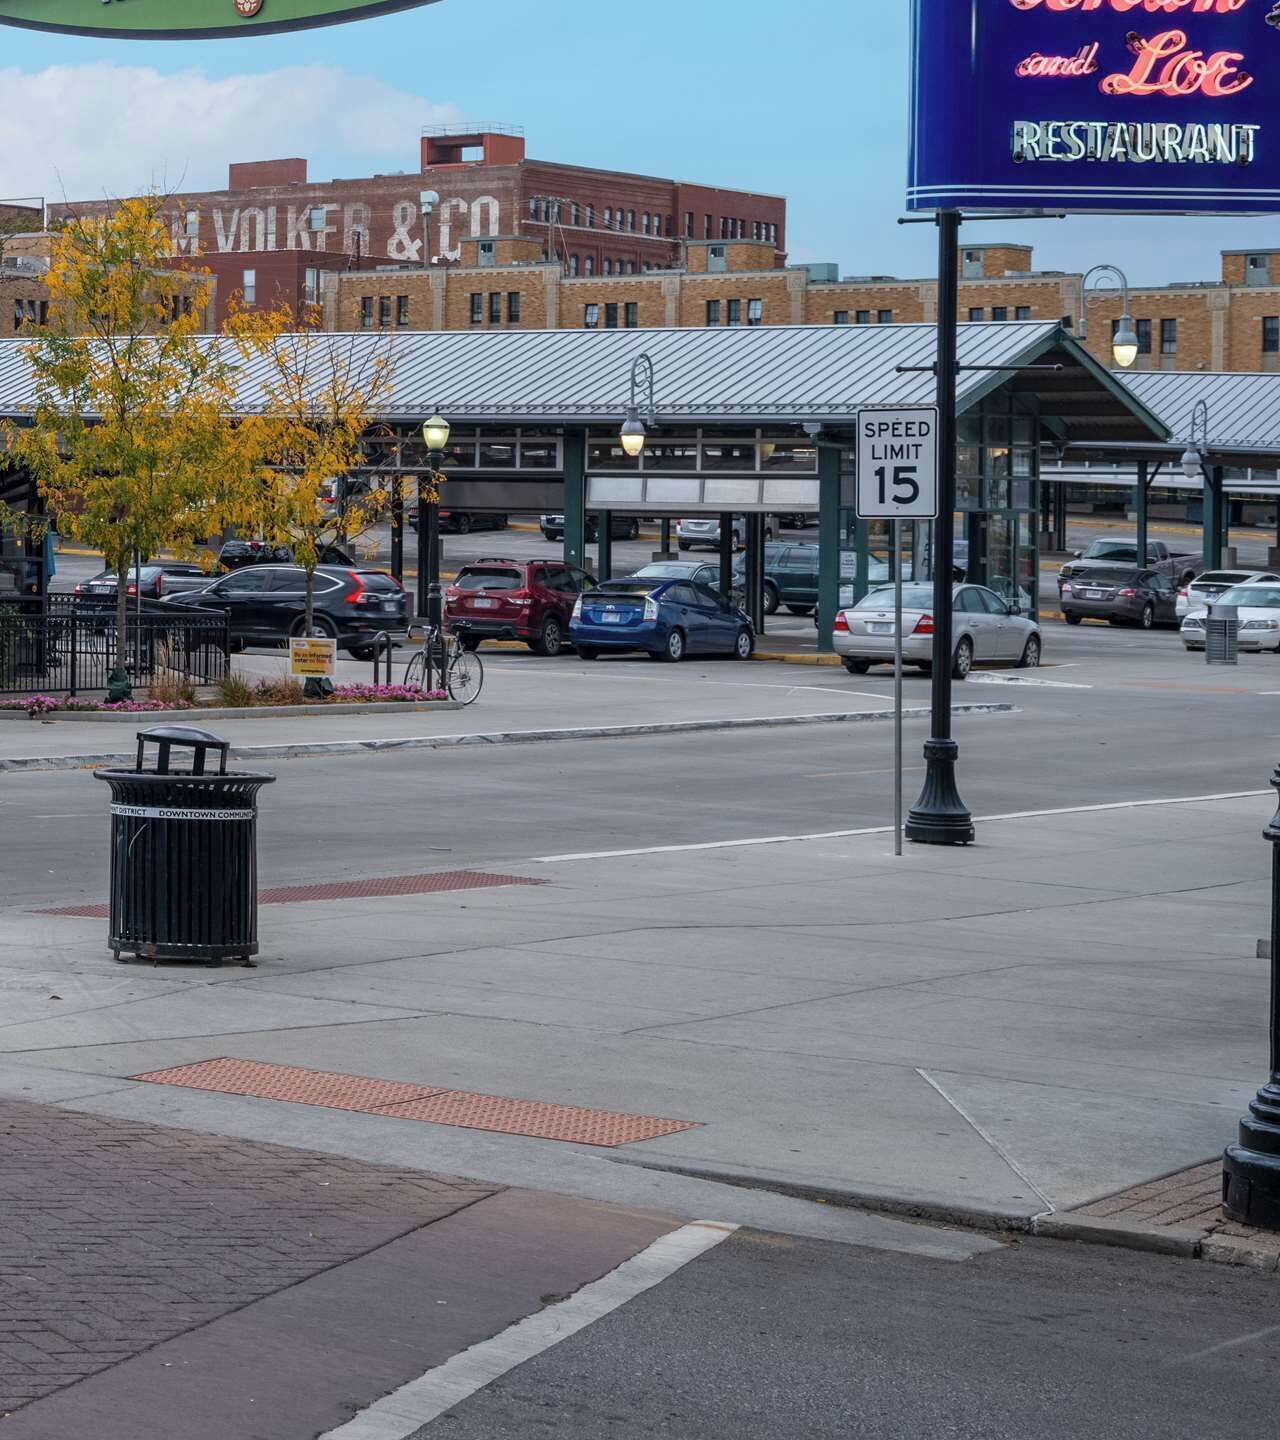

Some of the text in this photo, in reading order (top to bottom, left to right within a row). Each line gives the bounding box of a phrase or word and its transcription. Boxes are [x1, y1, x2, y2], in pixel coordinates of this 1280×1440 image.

[1015, 41, 1099, 78] and
[1013, 121, 1261, 166] RESTAURANT
[386, 199, 423, 261] &
[864, 421, 931, 438] SPEED
[871, 443, 923, 460] LIMIT
[874, 465, 920, 505] 15
[118, 807, 147, 816] DISTRICT
[159, 809, 216, 819] DOWNTOWN
[217, 810, 253, 819] COMMUNIT
